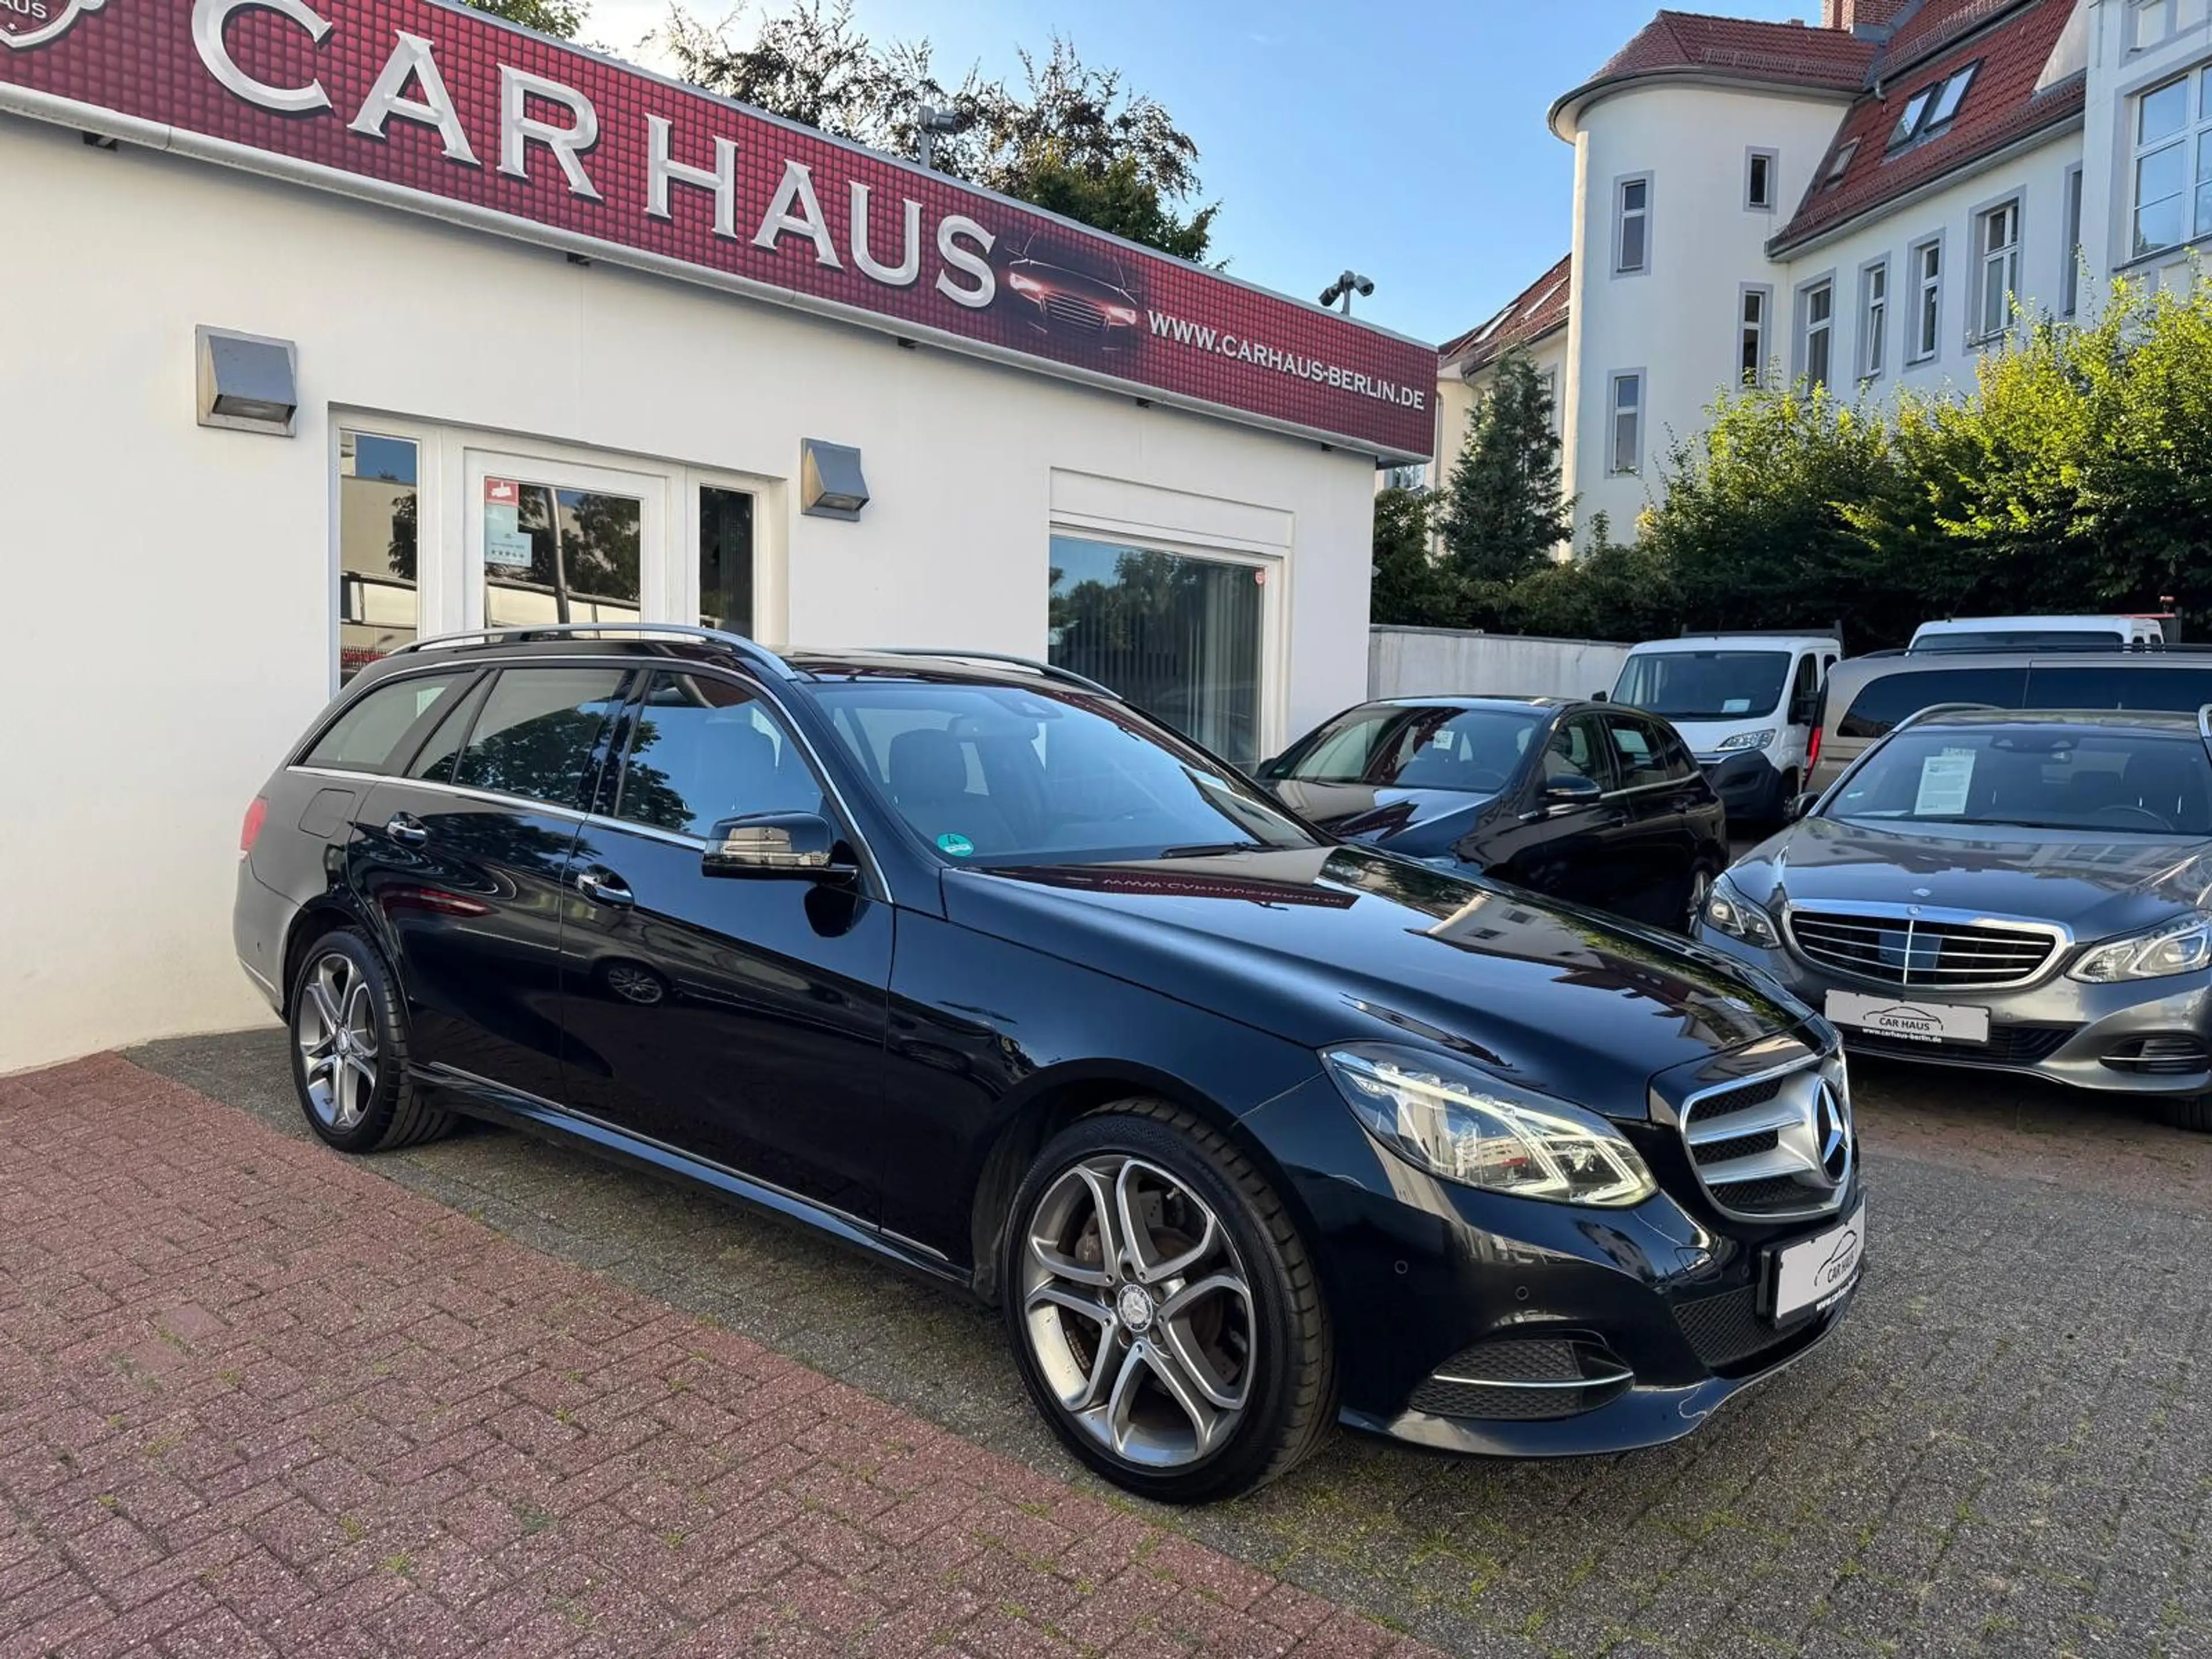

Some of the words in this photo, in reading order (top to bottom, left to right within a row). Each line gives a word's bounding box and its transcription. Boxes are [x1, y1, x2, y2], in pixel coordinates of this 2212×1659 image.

[191, 0, 604, 202] CAR
[644, 112, 997, 309] HAUS
[1147, 309, 1425, 411] WWW.CARHAUS-BERLIN.DE
[1878, 1017, 1899, 1027] CAR
[1902, 1020, 1930, 1031] HAUS
[1828, 1263, 1841, 1283] CAR
